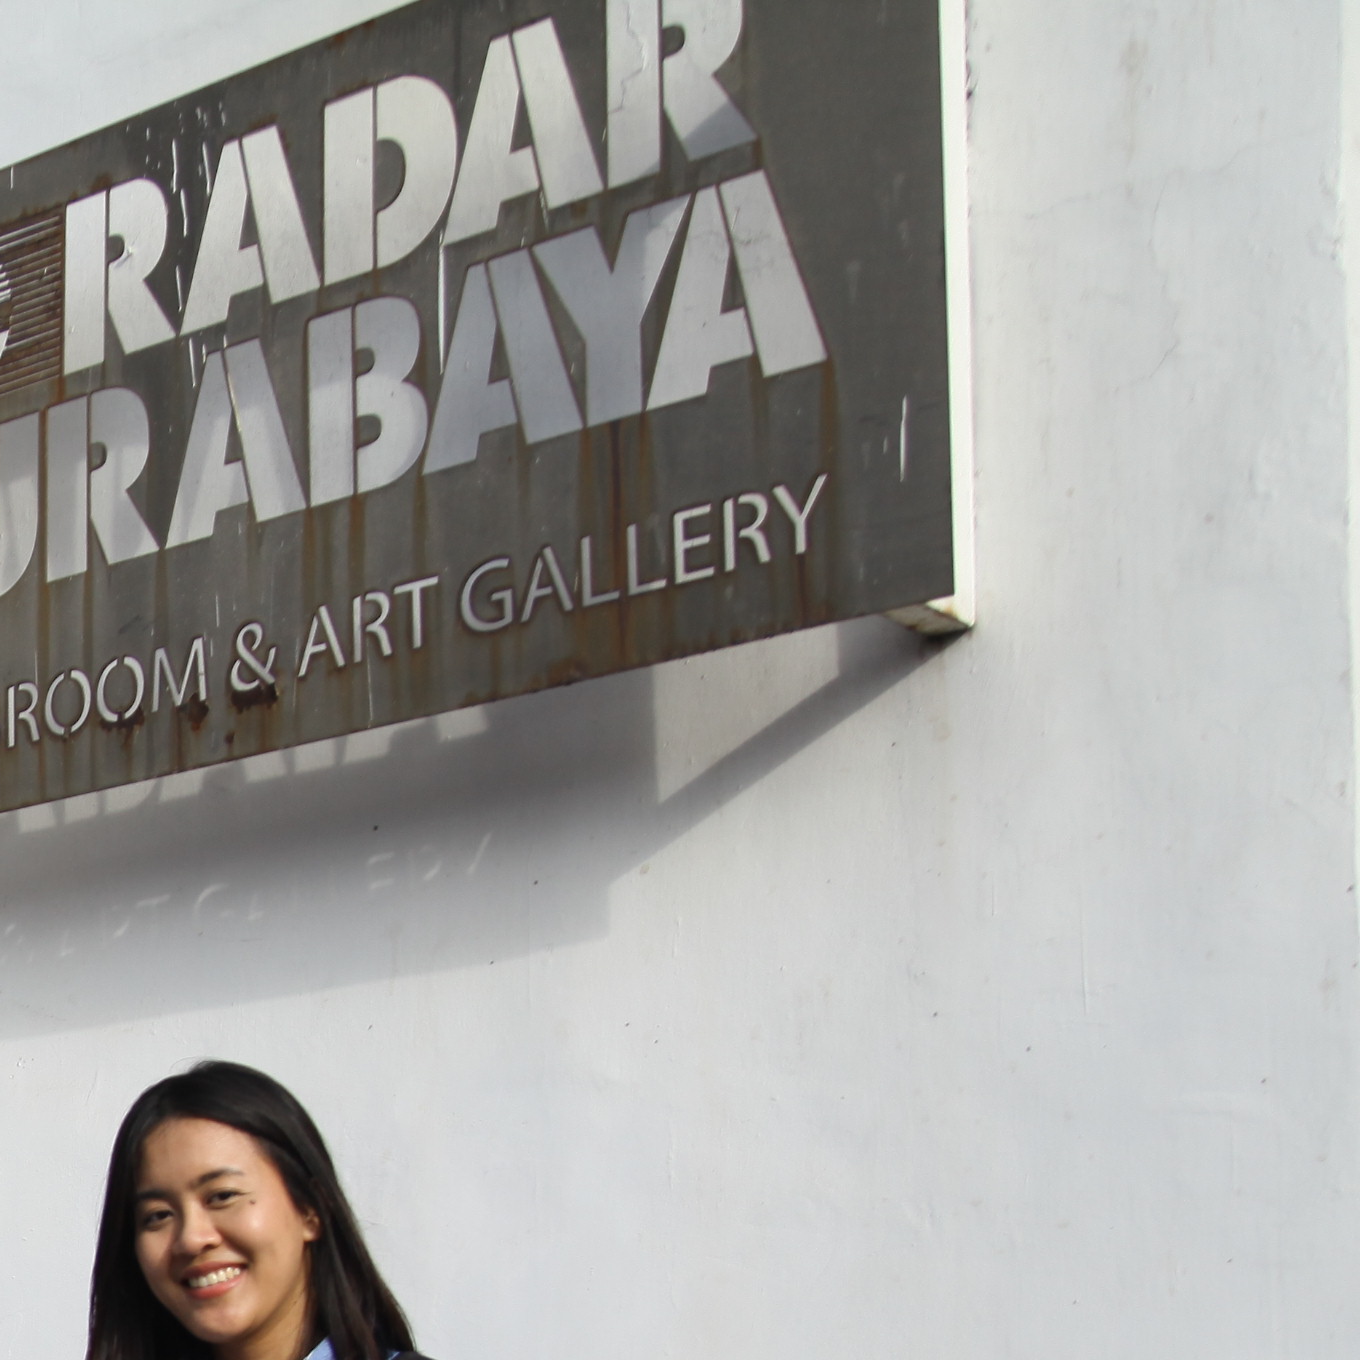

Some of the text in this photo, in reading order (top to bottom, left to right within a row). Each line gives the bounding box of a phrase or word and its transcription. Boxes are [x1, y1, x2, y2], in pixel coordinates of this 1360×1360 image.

[64, 0, 760, 378] RADAR
[230, 622, 277, 692] &
[297, 575, 440, 677] ART
[459, 473, 829, 634] GALLERY
